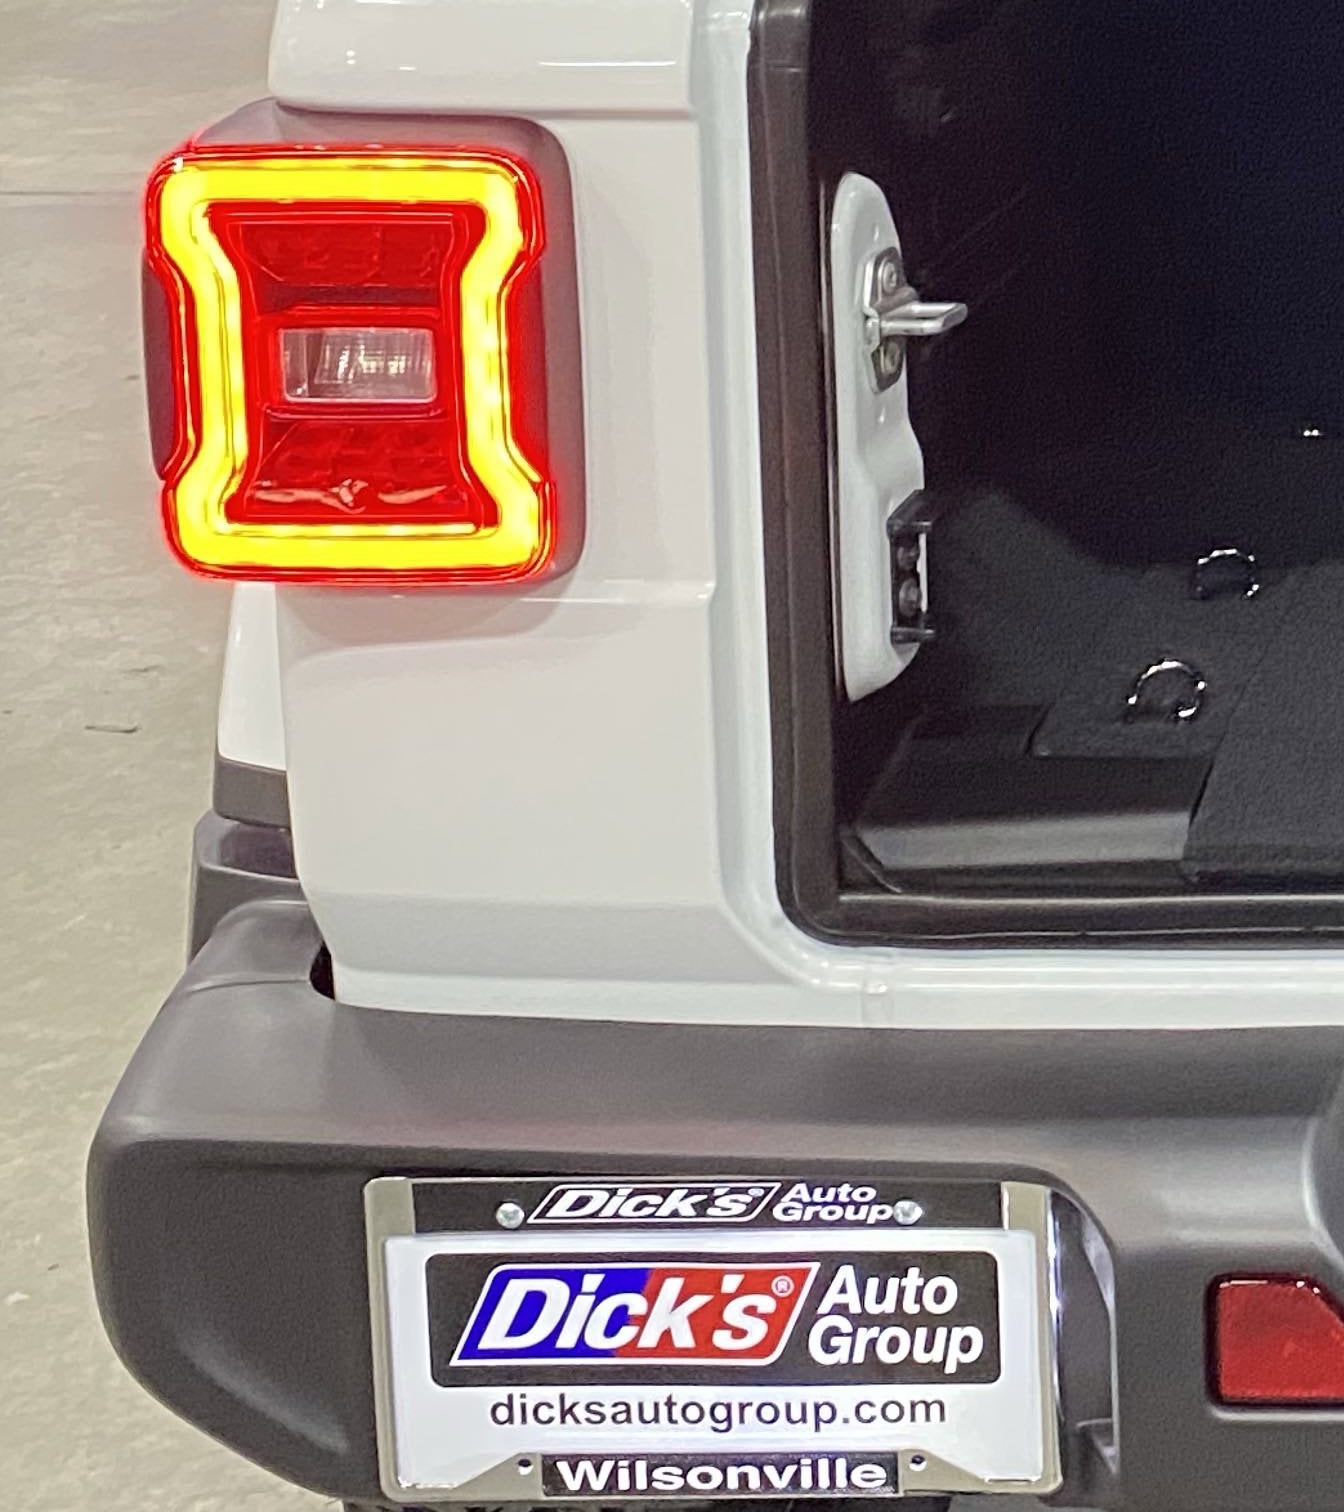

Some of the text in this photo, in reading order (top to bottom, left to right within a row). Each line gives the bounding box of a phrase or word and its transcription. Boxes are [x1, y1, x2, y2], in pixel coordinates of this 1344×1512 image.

[781, 1183, 876, 1203] Auto
[772, 1201, 893, 1225] Group
[816, 1264, 958, 1316] Auto
[806, 1314, 985, 1374] Group
[489, 1392, 947, 1433] dicksautogroup.com
[557, 1457, 888, 1492] Wilsonville
